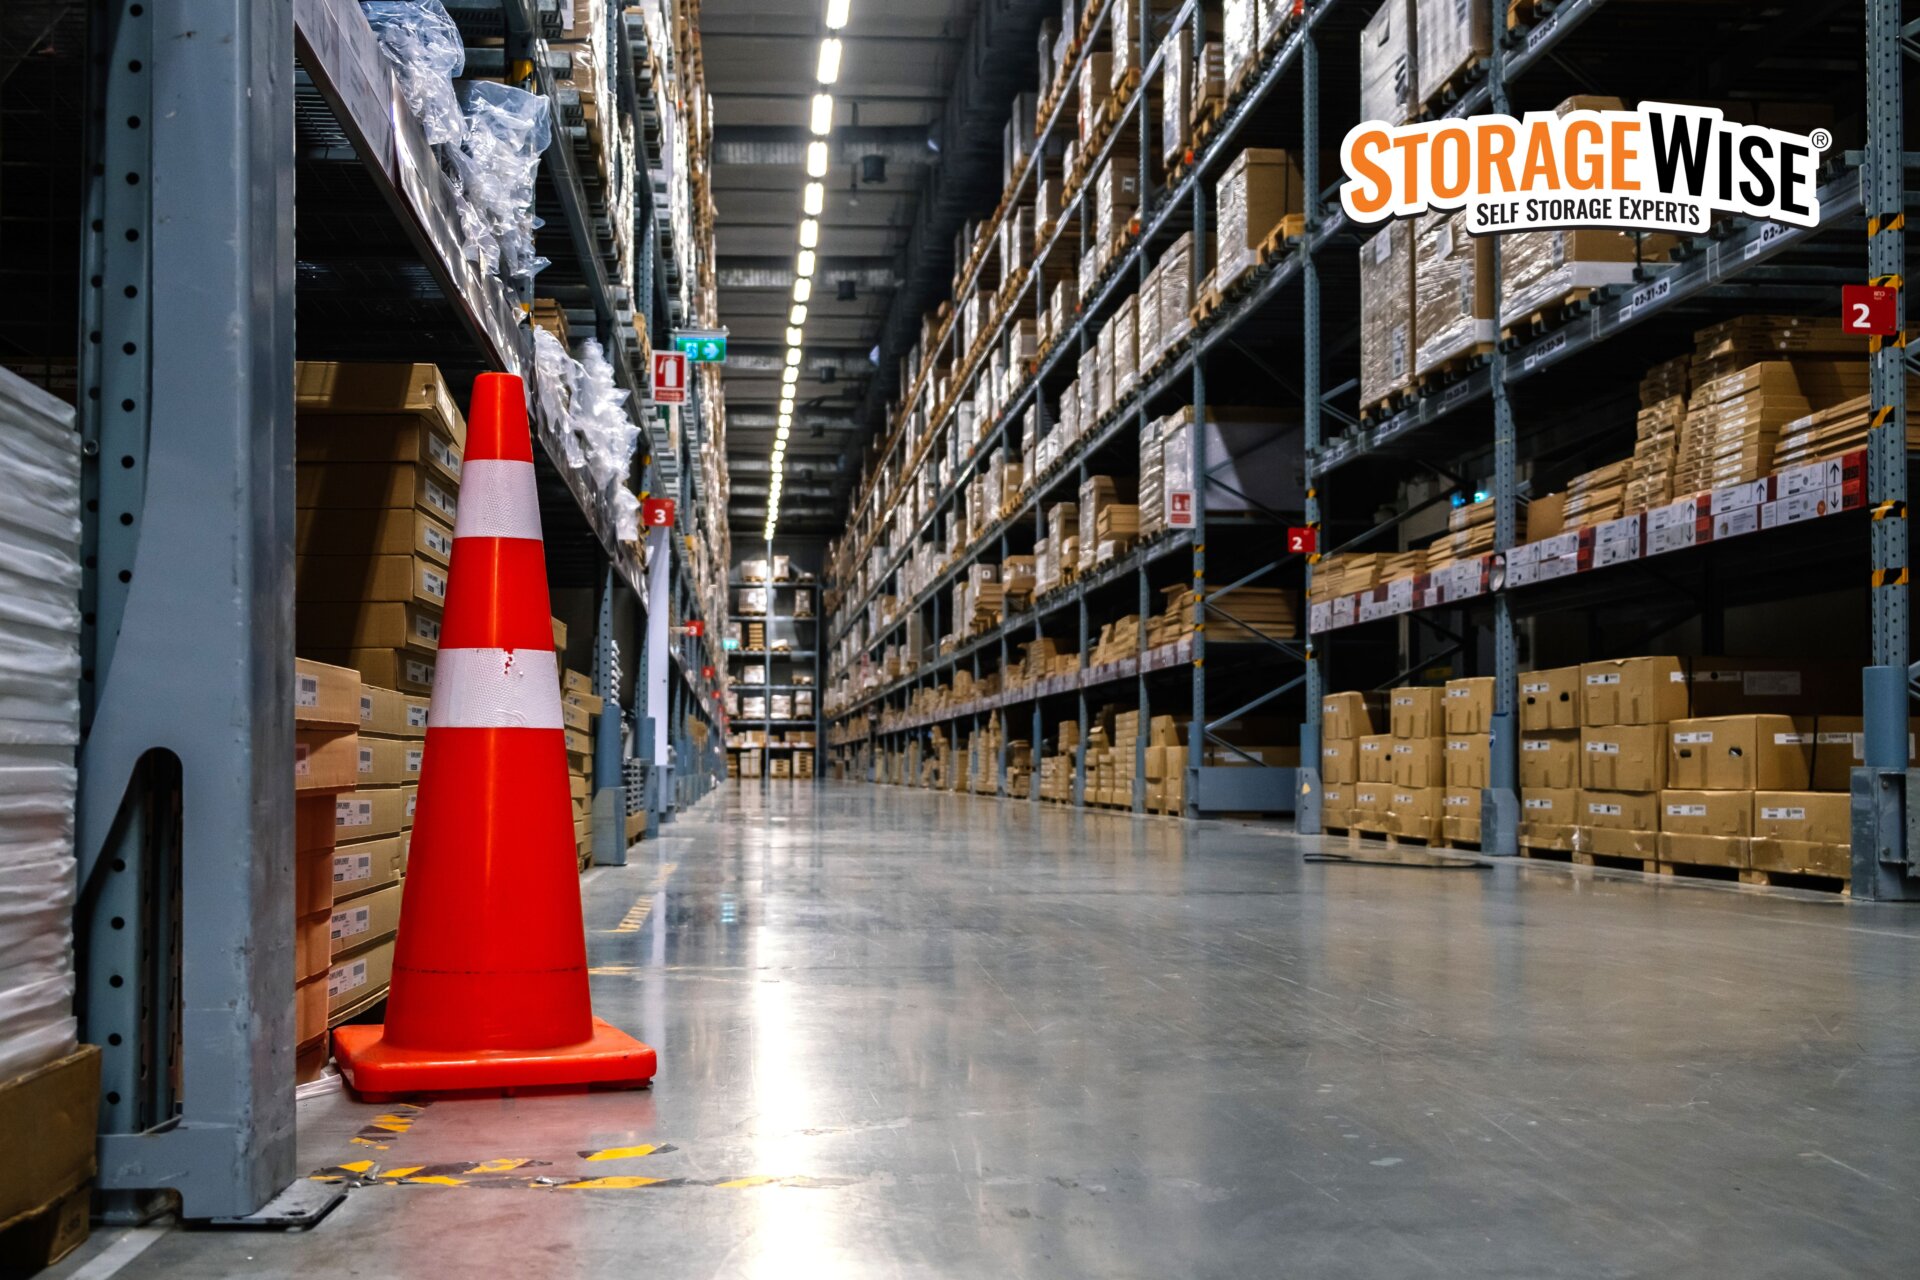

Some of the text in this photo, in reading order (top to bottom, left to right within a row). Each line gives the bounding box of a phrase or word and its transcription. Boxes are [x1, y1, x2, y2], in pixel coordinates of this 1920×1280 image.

[1852, 303, 1871, 328] 2
[654, 509, 666, 524] 3
[1292, 536, 1303, 550] 2
